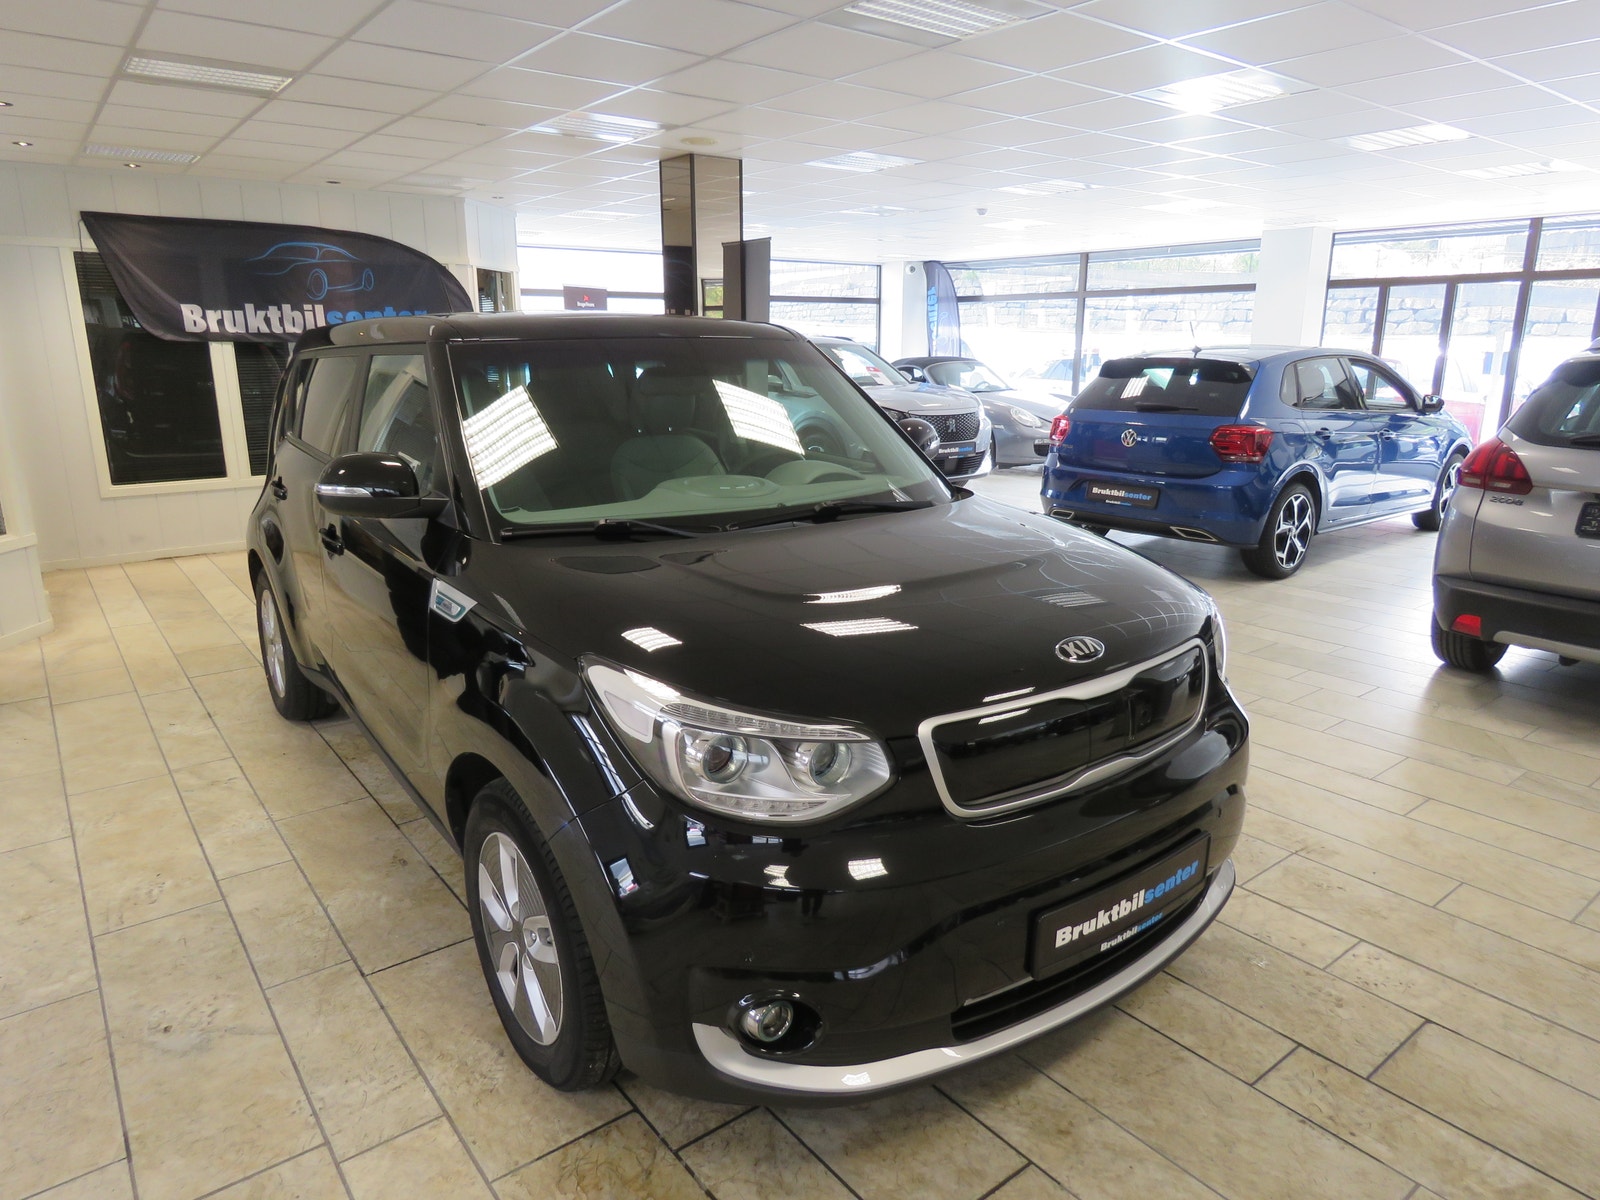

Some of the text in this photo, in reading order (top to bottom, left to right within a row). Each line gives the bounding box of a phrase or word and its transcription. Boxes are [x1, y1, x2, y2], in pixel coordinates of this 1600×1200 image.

[1092, 487, 1152, 500] Bruktbilsenter
[1061, 638, 1101, 659] KIA
[1055, 860, 1199, 948] Bruktbilsenter
[1100, 912, 1163, 951] Bruktbilsenter
